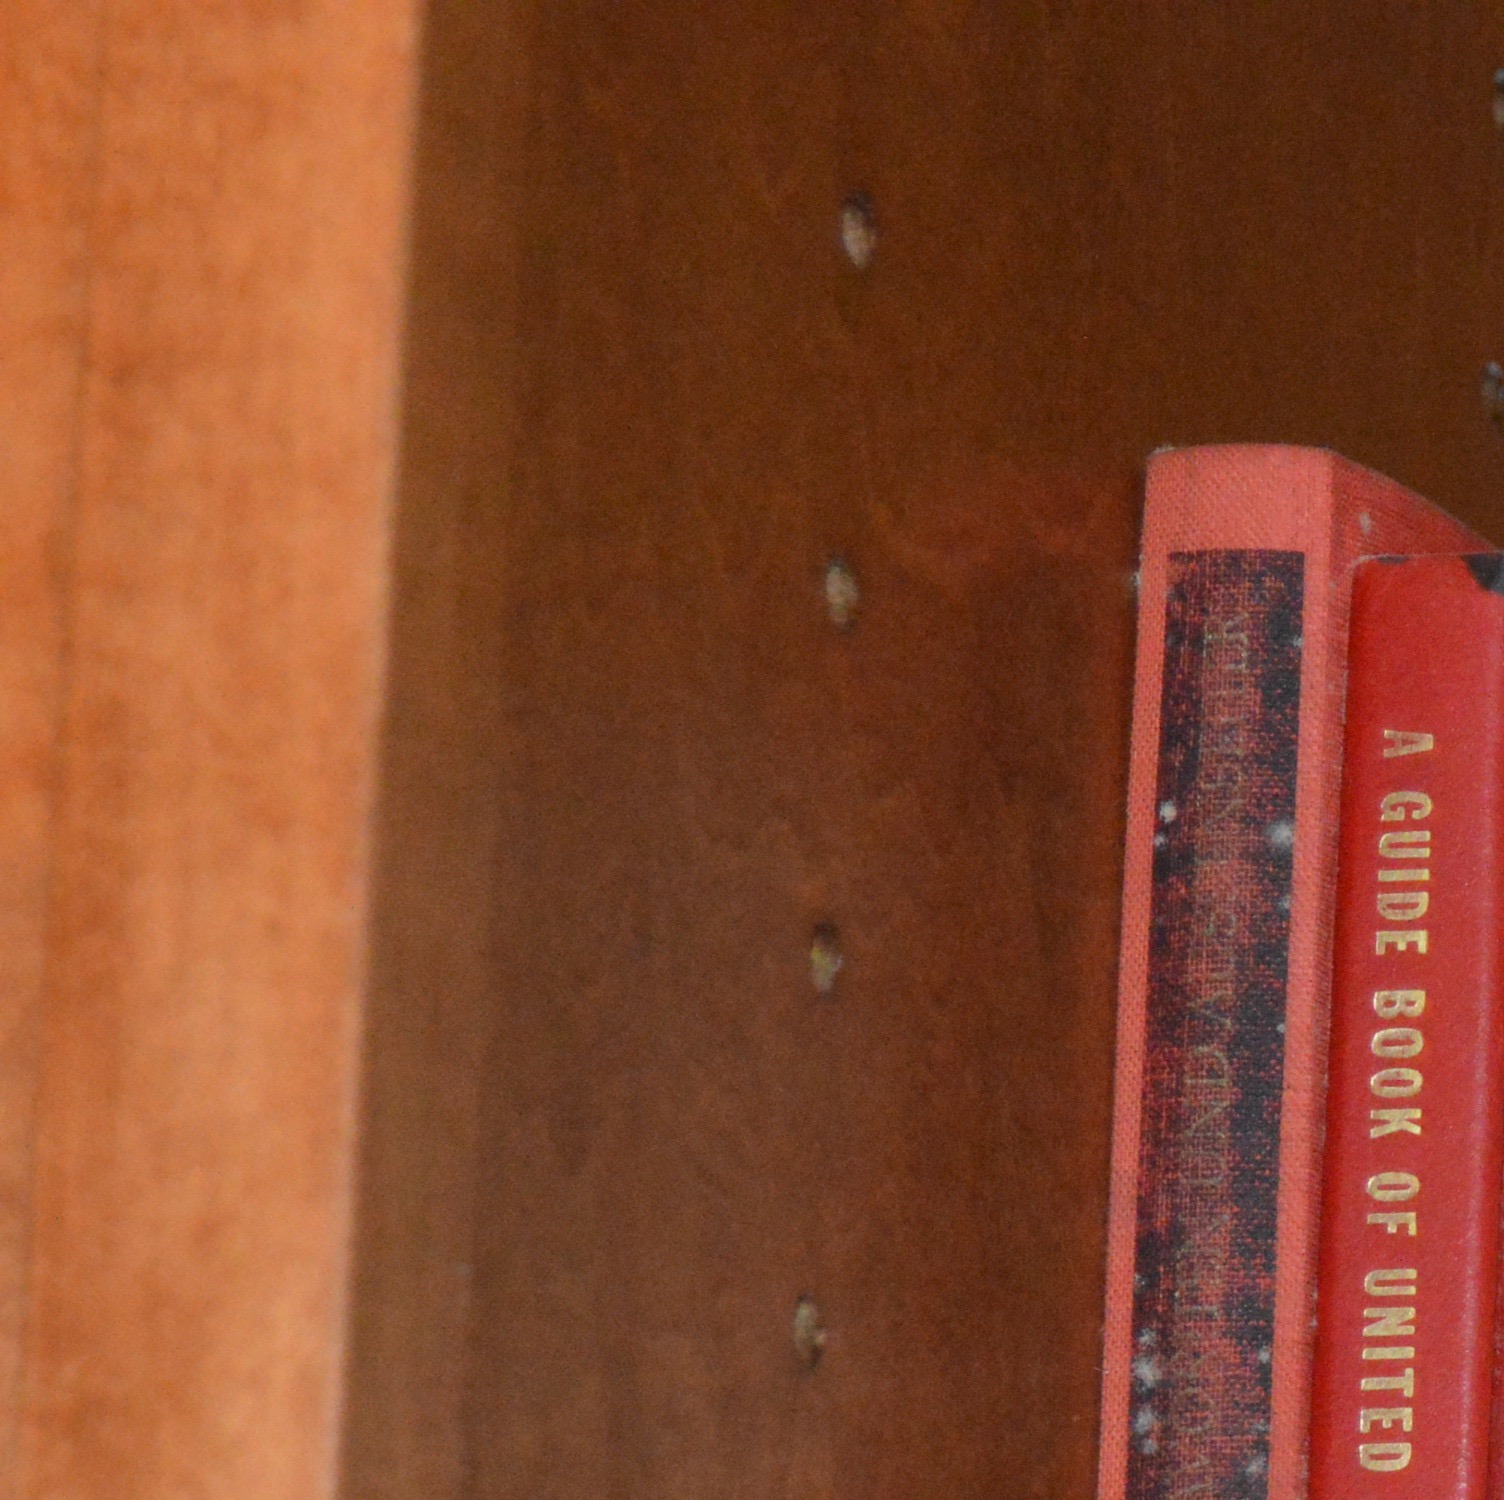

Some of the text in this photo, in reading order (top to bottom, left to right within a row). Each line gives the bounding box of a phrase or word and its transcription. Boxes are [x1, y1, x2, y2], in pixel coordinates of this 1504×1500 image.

[1382, 730, 1434, 758] A
[1375, 790, 1433, 955] GUIDE
[1369, 990, 1425, 1137] BOOK
[1363, 1171, 1421, 1236] OF
[1358, 1269, 1417, 1472] UNITED
